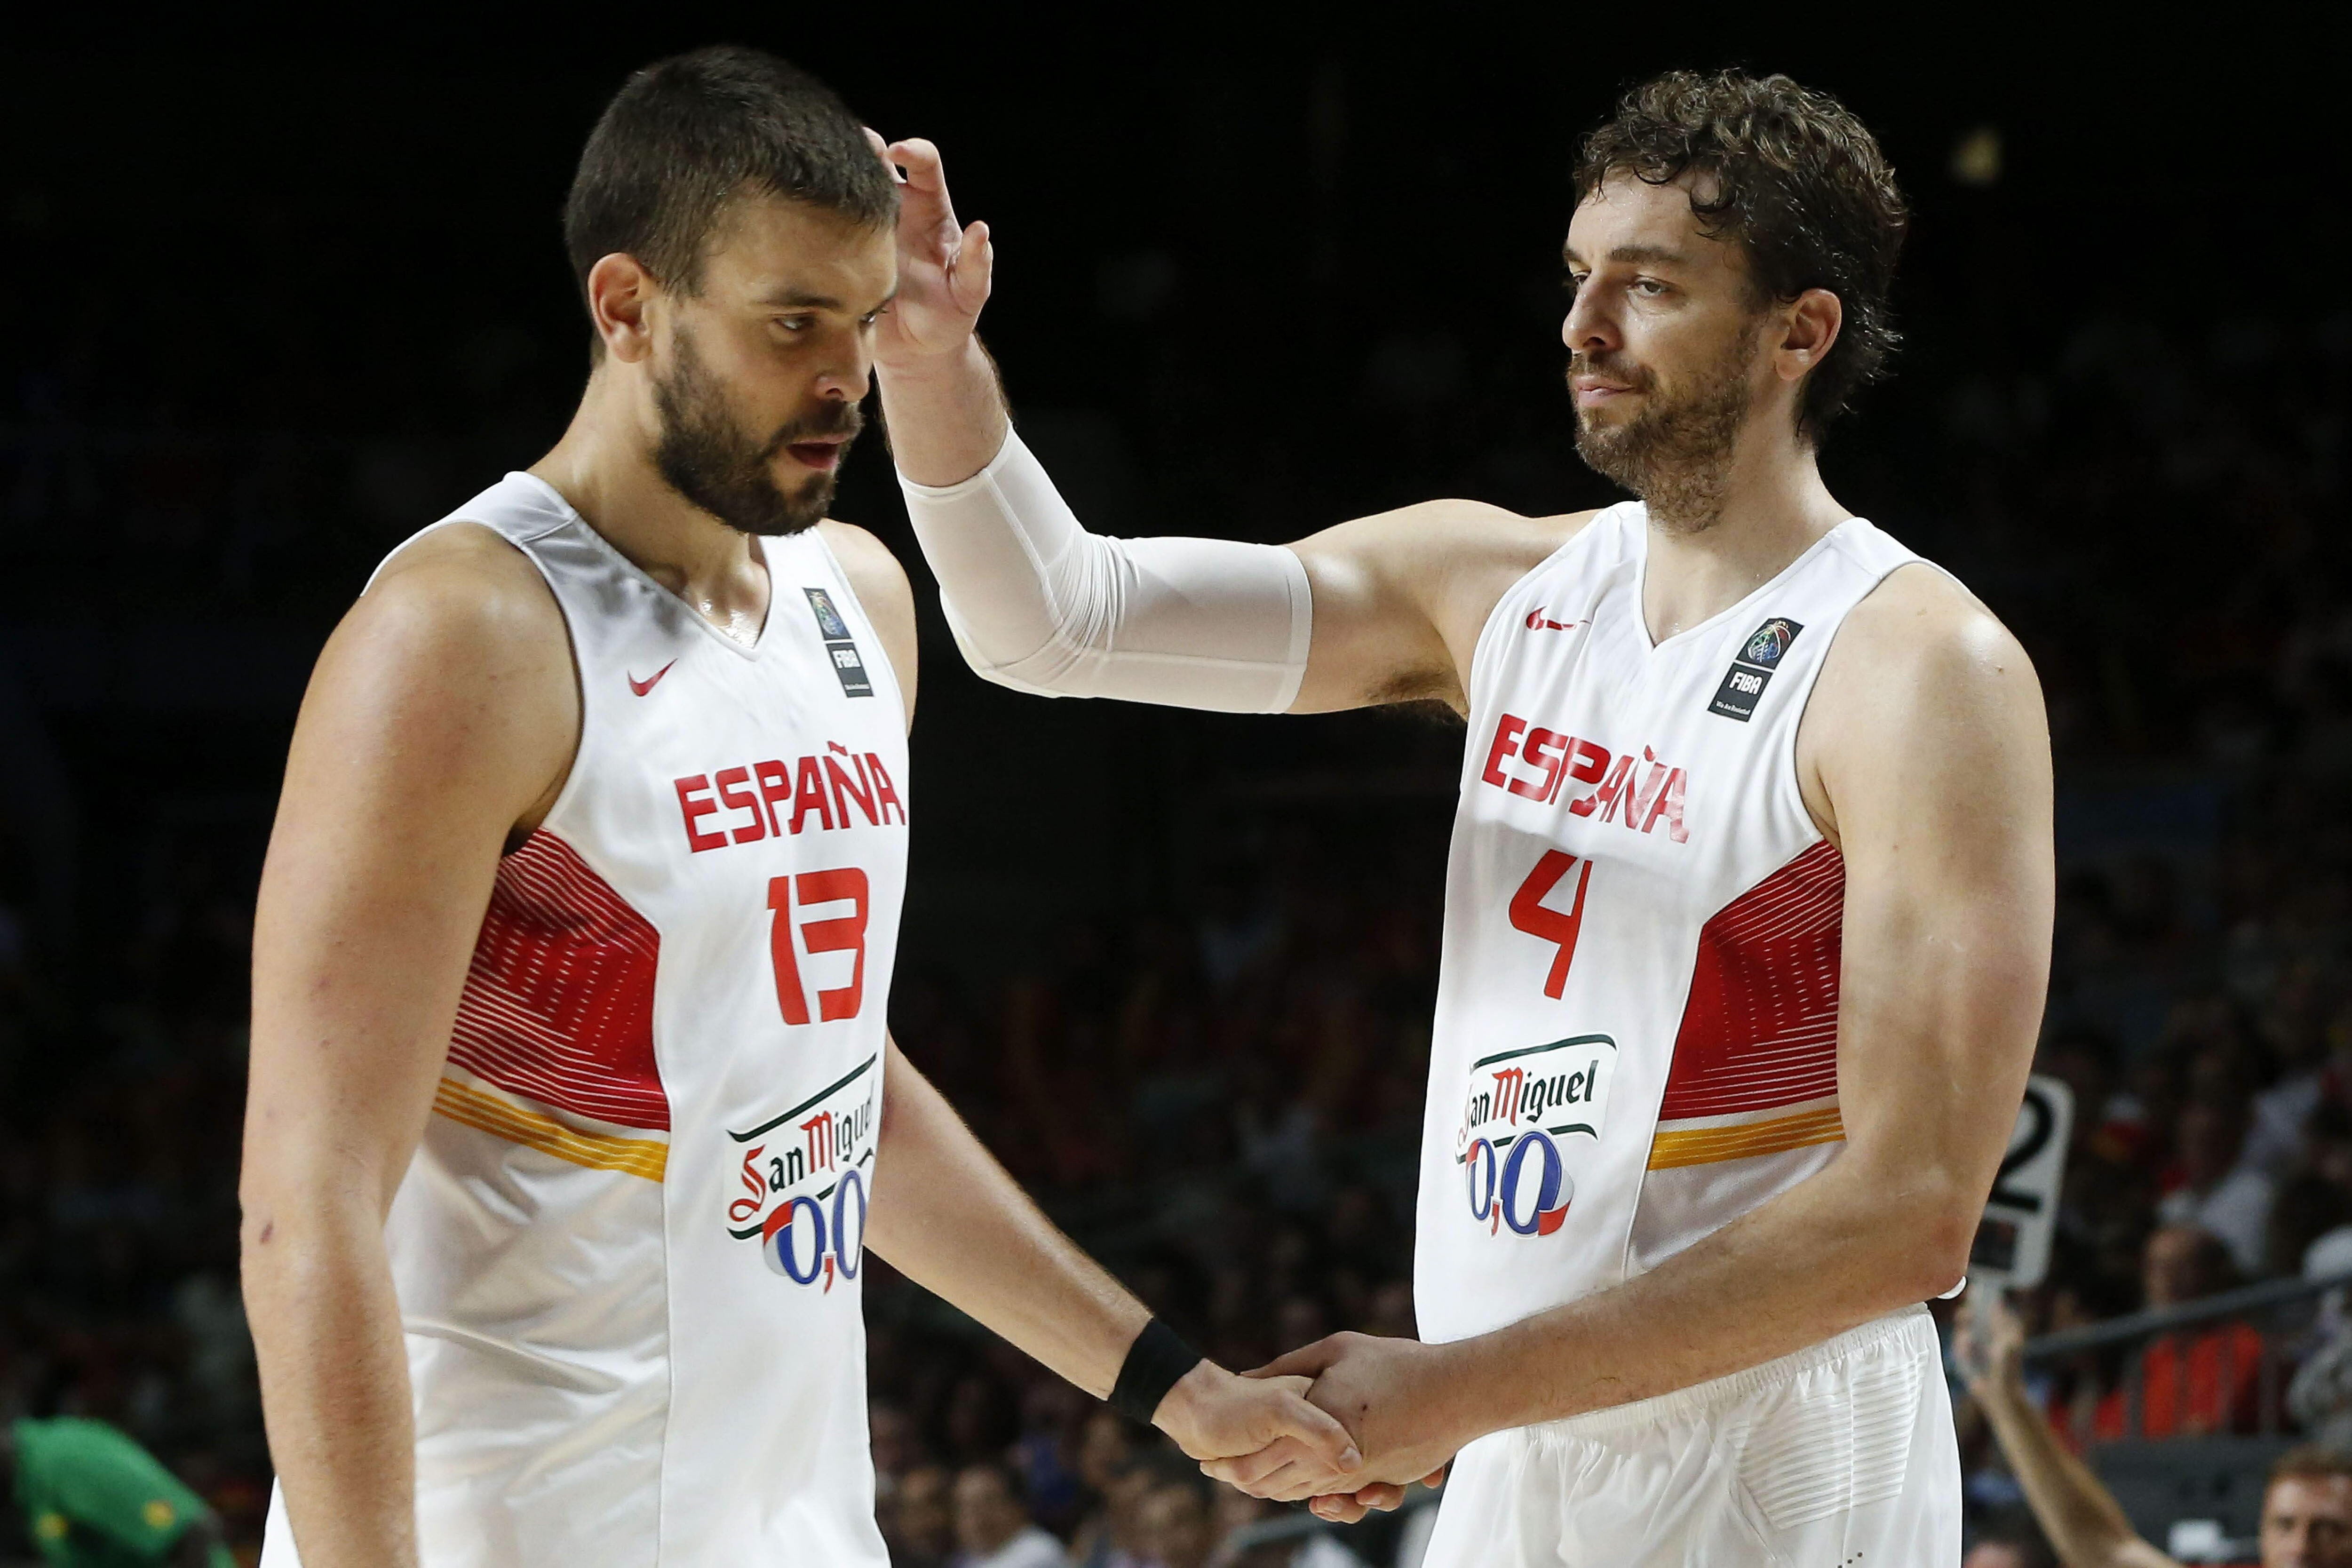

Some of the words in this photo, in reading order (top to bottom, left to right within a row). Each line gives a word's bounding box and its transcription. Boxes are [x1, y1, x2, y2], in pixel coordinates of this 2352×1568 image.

[1729, 672, 1763, 695] FIBA
[674, 740, 906, 853] ESPAÑA
[1482, 713, 1690, 844] ESPAÑA
[766, 867, 869, 1025] 13
[1509, 849, 1593, 1000] 4
[1492, 1059, 1599, 1127] Miguel
[1989, 1090, 2055, 1214] 2
[729, 1144, 804, 1222] San
[764, 1170, 866, 1295] 0,0
[1466, 1130, 1571, 1236] 0,0
